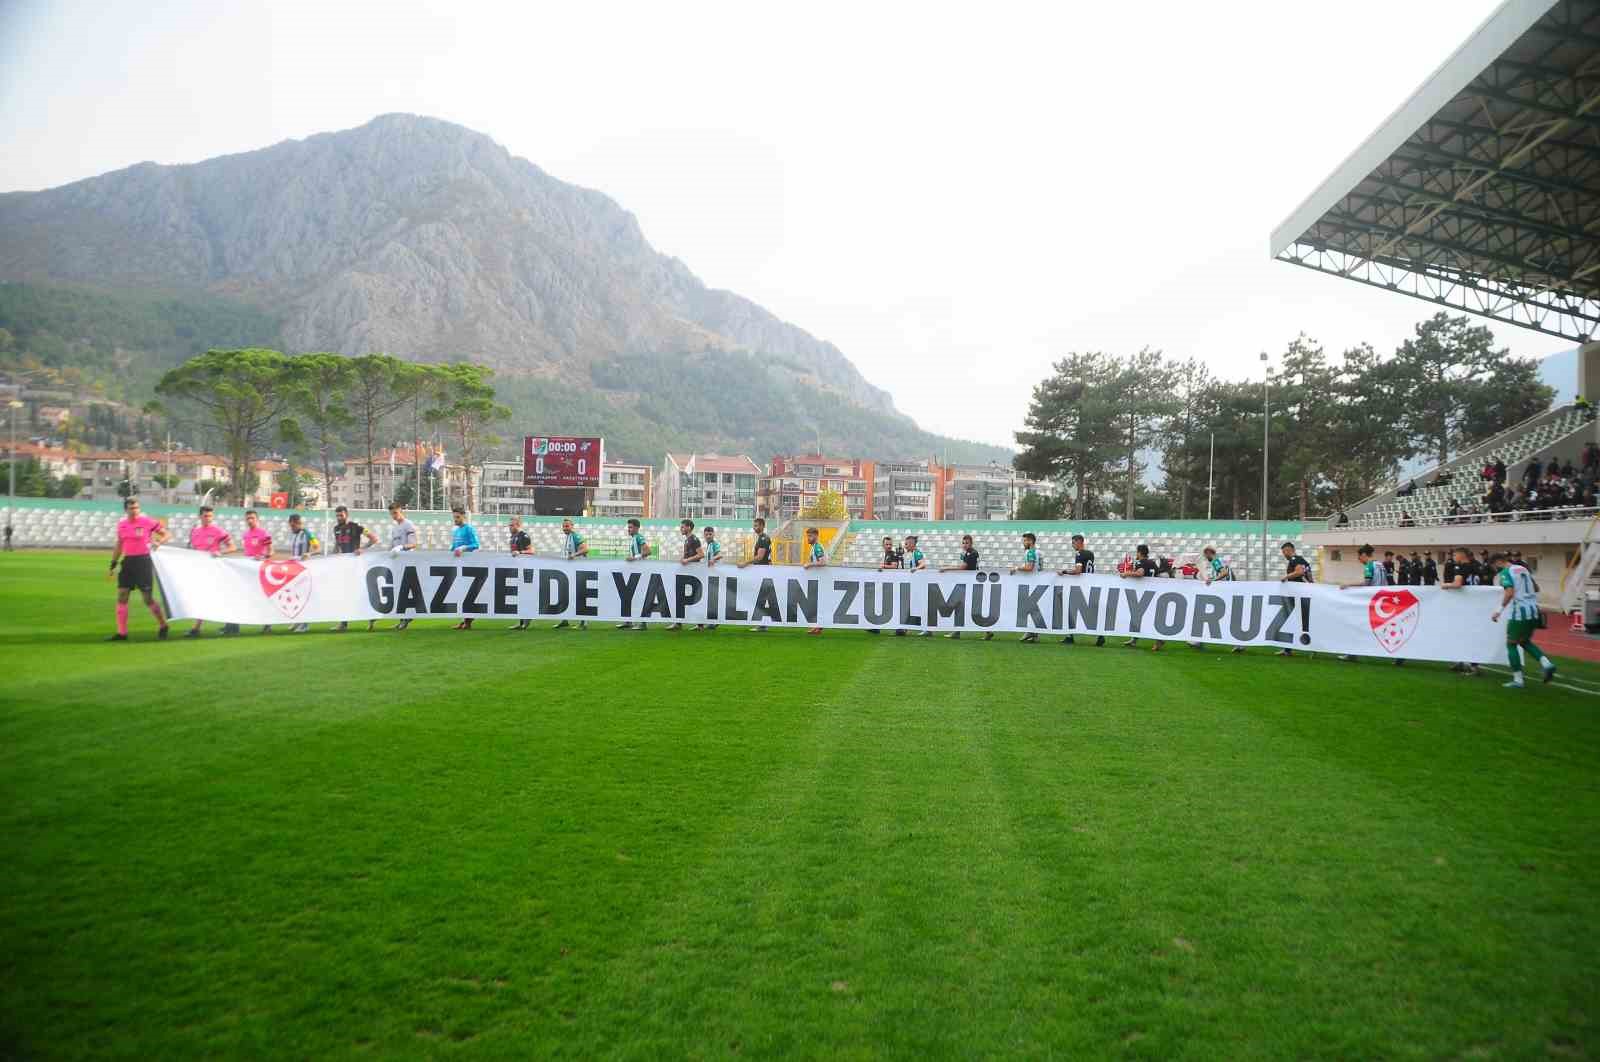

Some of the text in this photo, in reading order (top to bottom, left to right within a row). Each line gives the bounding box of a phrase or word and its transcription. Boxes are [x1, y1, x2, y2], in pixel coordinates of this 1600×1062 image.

[548, 442, 576, 452] 00:00
[535, 457, 543, 474] 0
[578, 458, 586, 475] 0
[366, 566, 1312, 646] GAZZE'DE YAPILAN ZULMÜ KINIYORUZ!
